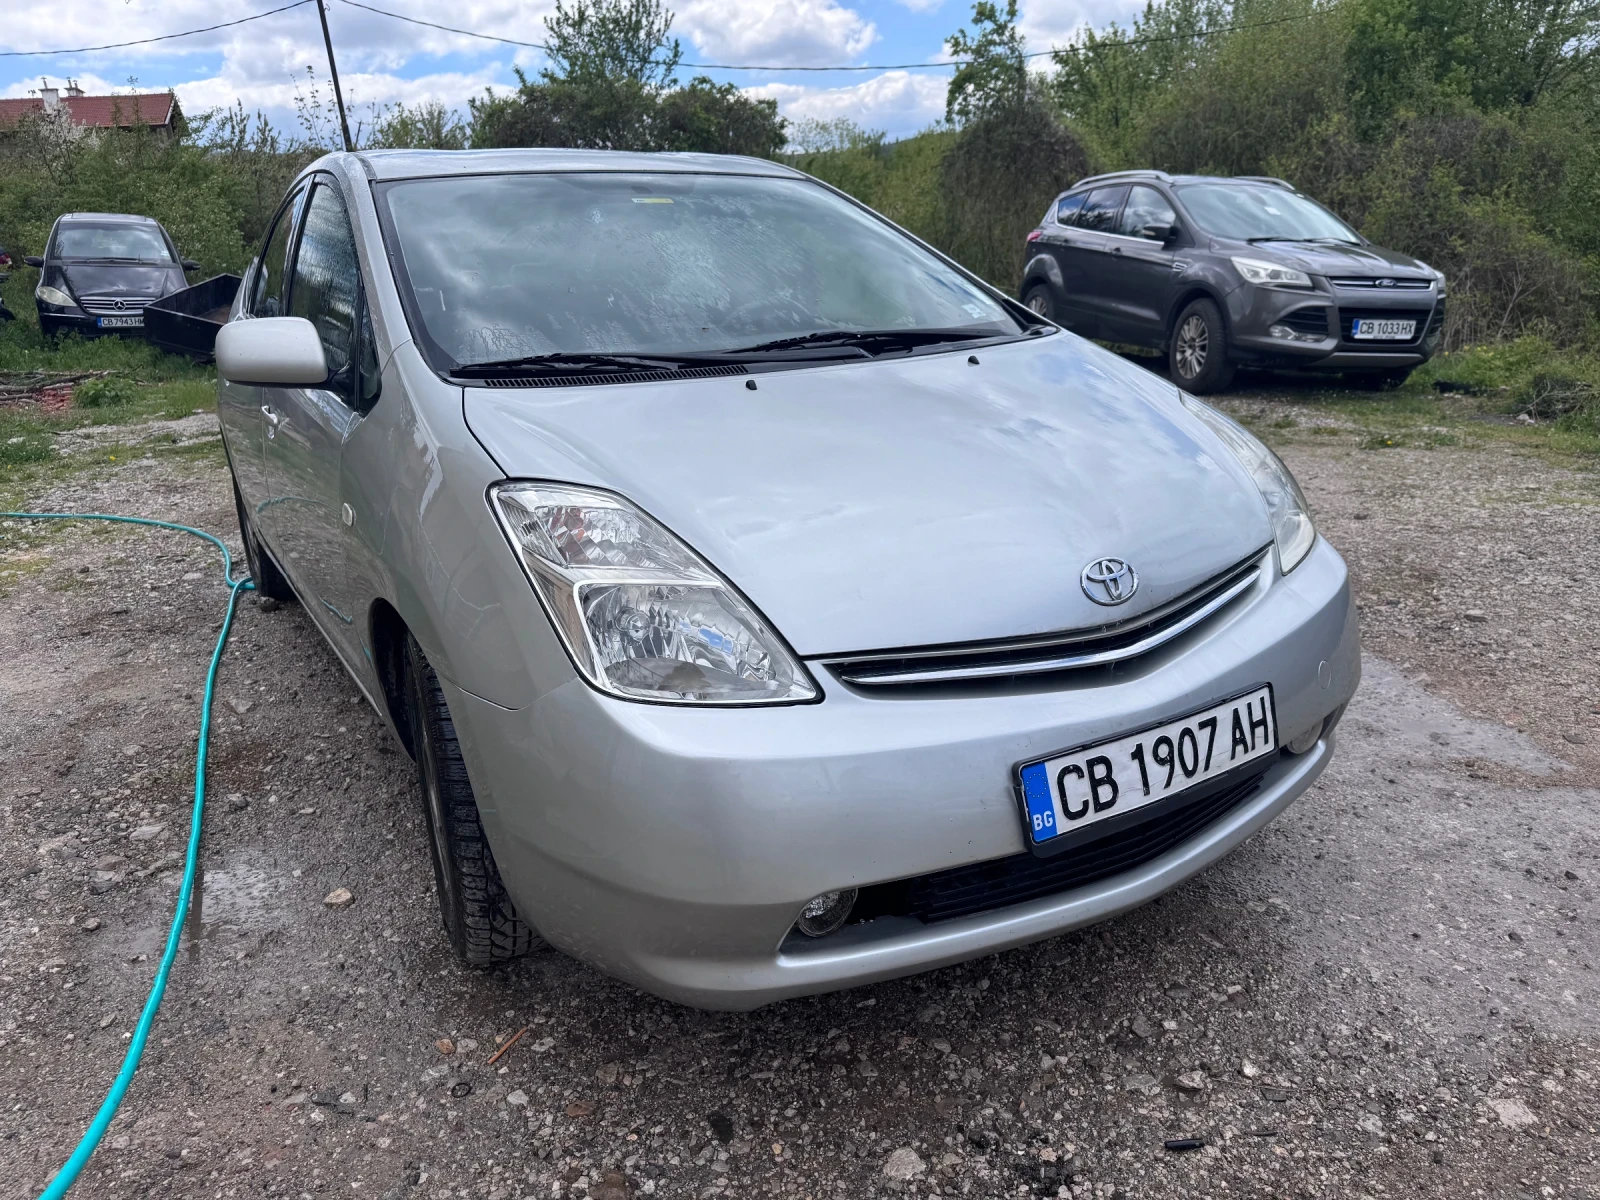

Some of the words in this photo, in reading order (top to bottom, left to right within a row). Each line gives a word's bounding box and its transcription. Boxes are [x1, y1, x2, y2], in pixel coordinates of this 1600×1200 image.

[102, 318, 113, 326] CB
[114, 318, 133, 326] 7943
[1360, 322, 1374, 334] CB
[1378, 322, 1400, 334] 1033
[1401, 322, 1414, 335] HX
[1056, 754, 1119, 821] CB
[1130, 715, 1218, 797] 1907
[1230, 696, 1269, 761] AH
[1032, 810, 1054, 831] BG
